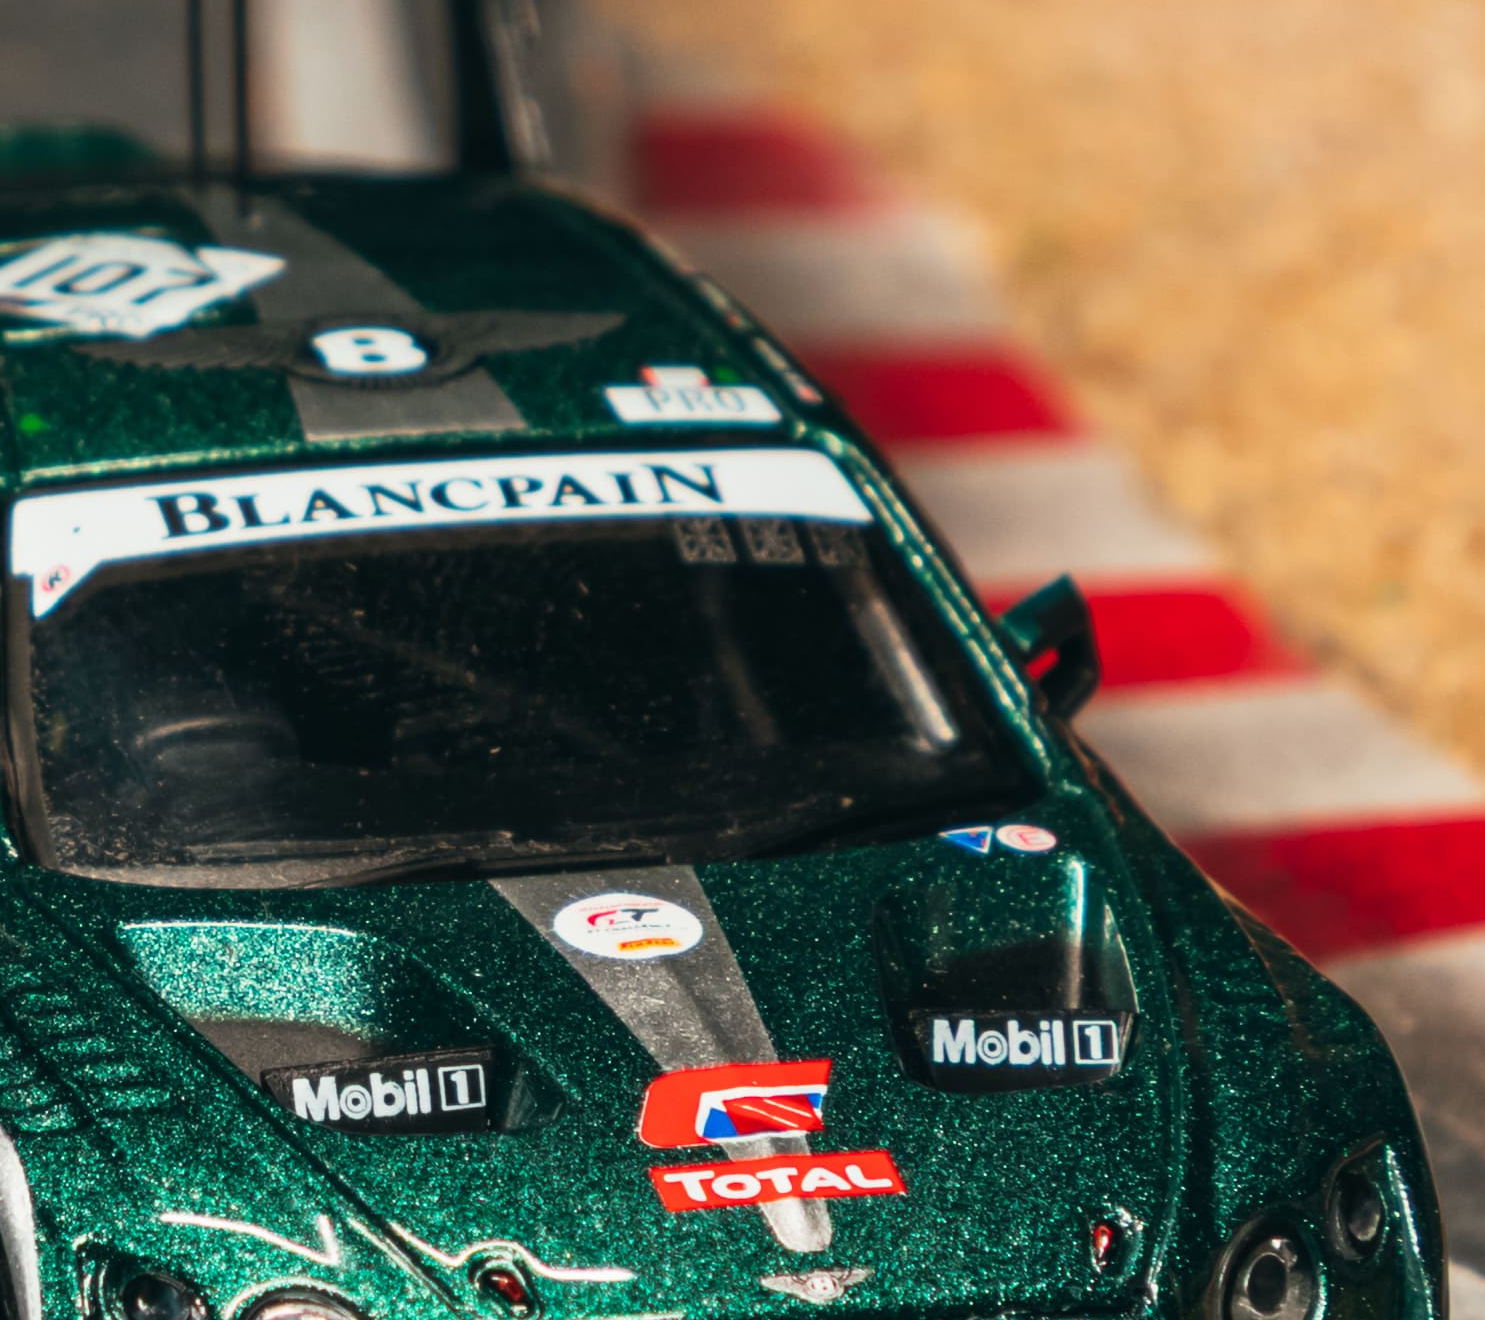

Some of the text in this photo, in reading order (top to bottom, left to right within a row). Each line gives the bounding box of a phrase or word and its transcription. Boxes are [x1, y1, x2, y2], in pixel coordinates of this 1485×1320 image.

[643, 385, 746, 413] PRO
[146, 462, 724, 539] BLANCPAIN
[933, 1019, 1066, 1065] Mobil
[292, 1068, 432, 1122] Mobil
[664, 1163, 893, 1203] TOTAL
